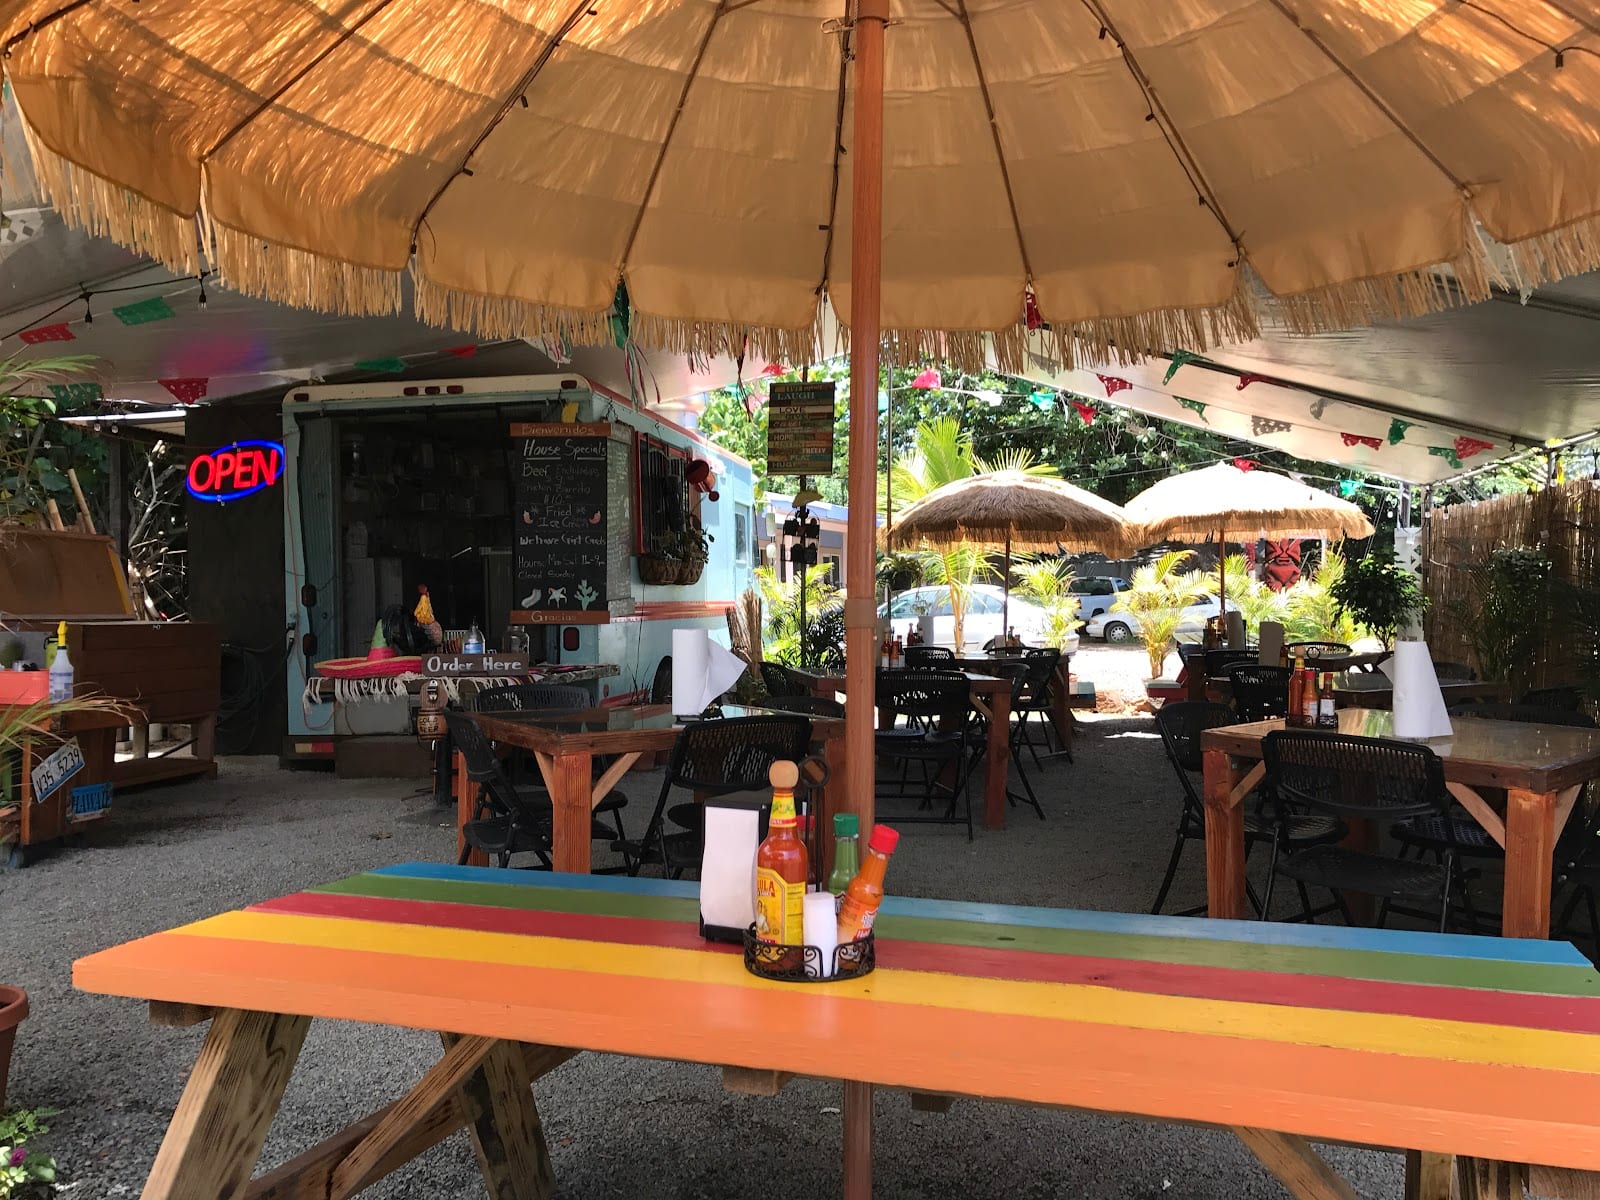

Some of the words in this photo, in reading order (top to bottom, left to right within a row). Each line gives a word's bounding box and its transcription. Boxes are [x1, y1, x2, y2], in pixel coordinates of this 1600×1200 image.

[777, 392, 815, 400] LAUGH
[523, 439, 561, 457] House
[564, 438, 607, 461] Specials
[189, 449, 278, 493] OPEN
[521, 462, 551, 477] Beef
[546, 504, 573, 517] Fried
[537, 516, 561, 528] Ice
[520, 535, 534, 545] We
[535, 534, 560, 545] have
[531, 610, 577, 623] Gracias
[427, 656, 473, 672] Order
[483, 656, 523, 671] Here
[58, 748, 80, 776] 5239
